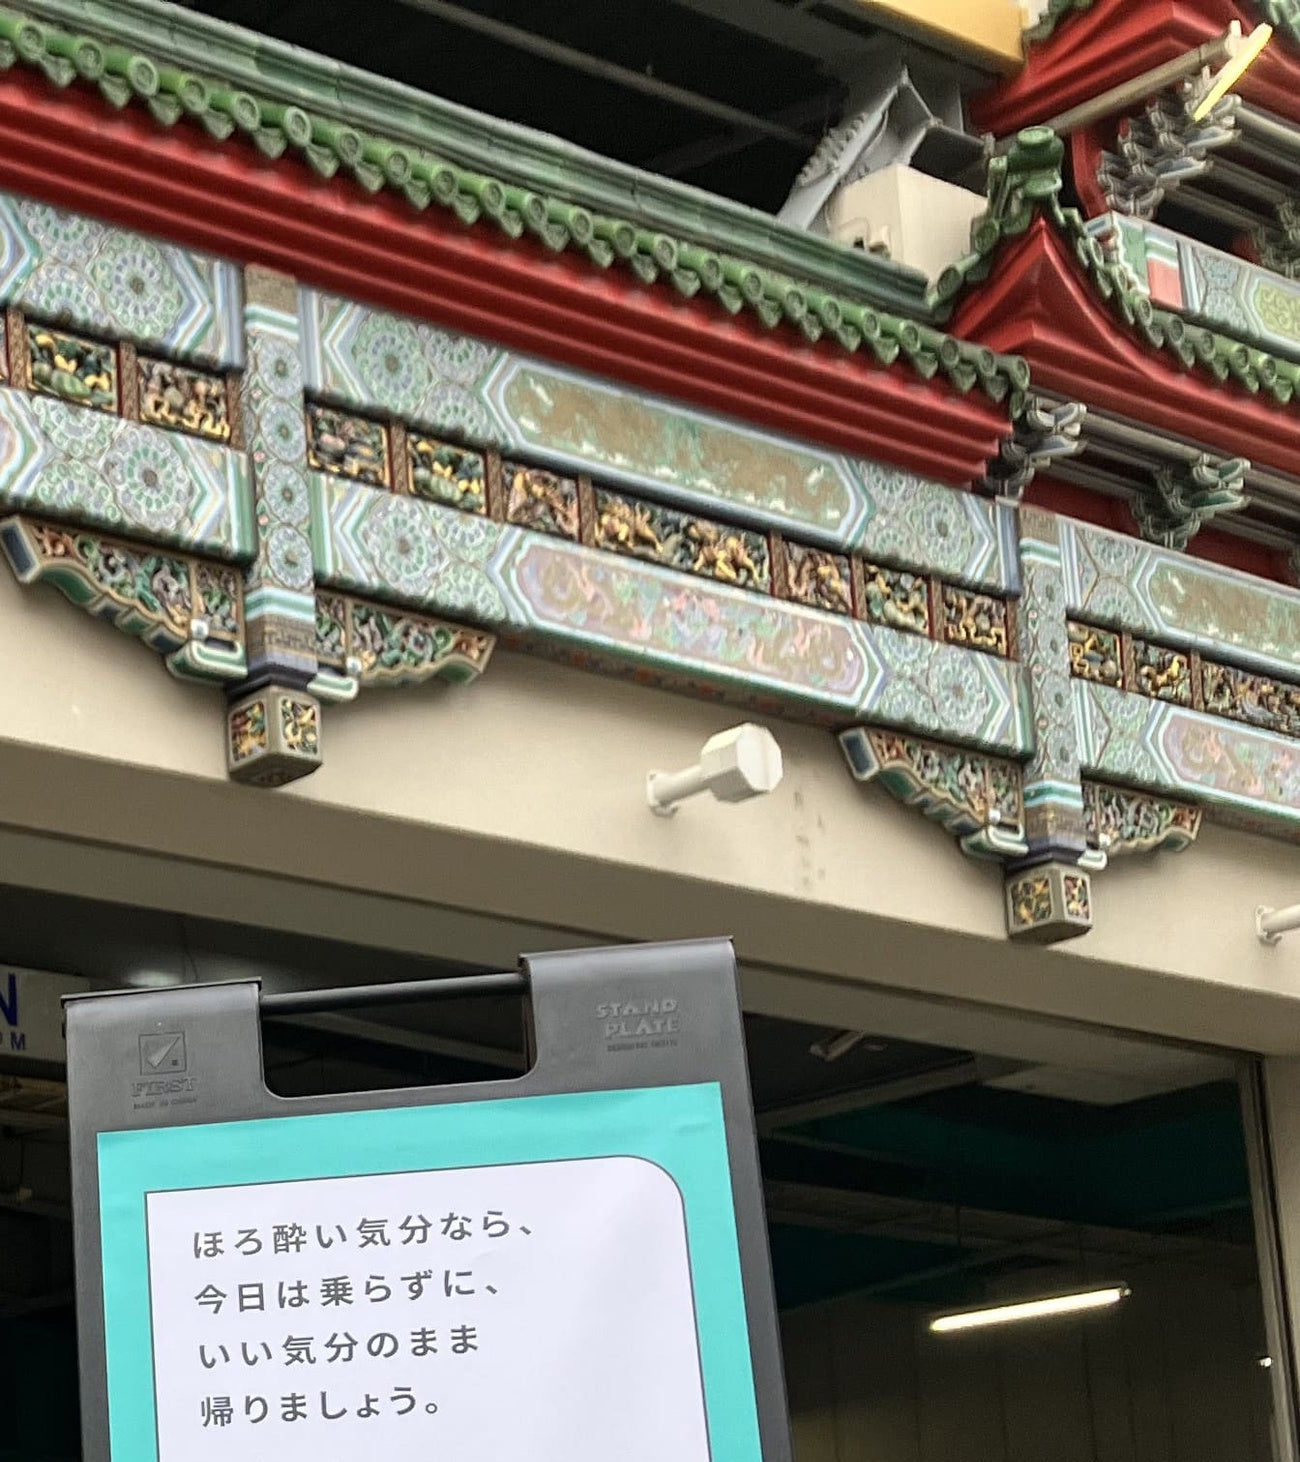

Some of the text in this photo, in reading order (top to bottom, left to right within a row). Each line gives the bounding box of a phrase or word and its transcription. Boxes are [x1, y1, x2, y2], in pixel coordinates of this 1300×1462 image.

[605, 1018, 680, 1039] PLATE
[192, 1209, 533, 1260] ほろ酔い気分なら、
[193, 1268, 500, 1315] 今日は乗らずに、
[198, 1323, 479, 1370] いい気分のまま
[200, 1385, 439, 1429] 帰りましょう。
